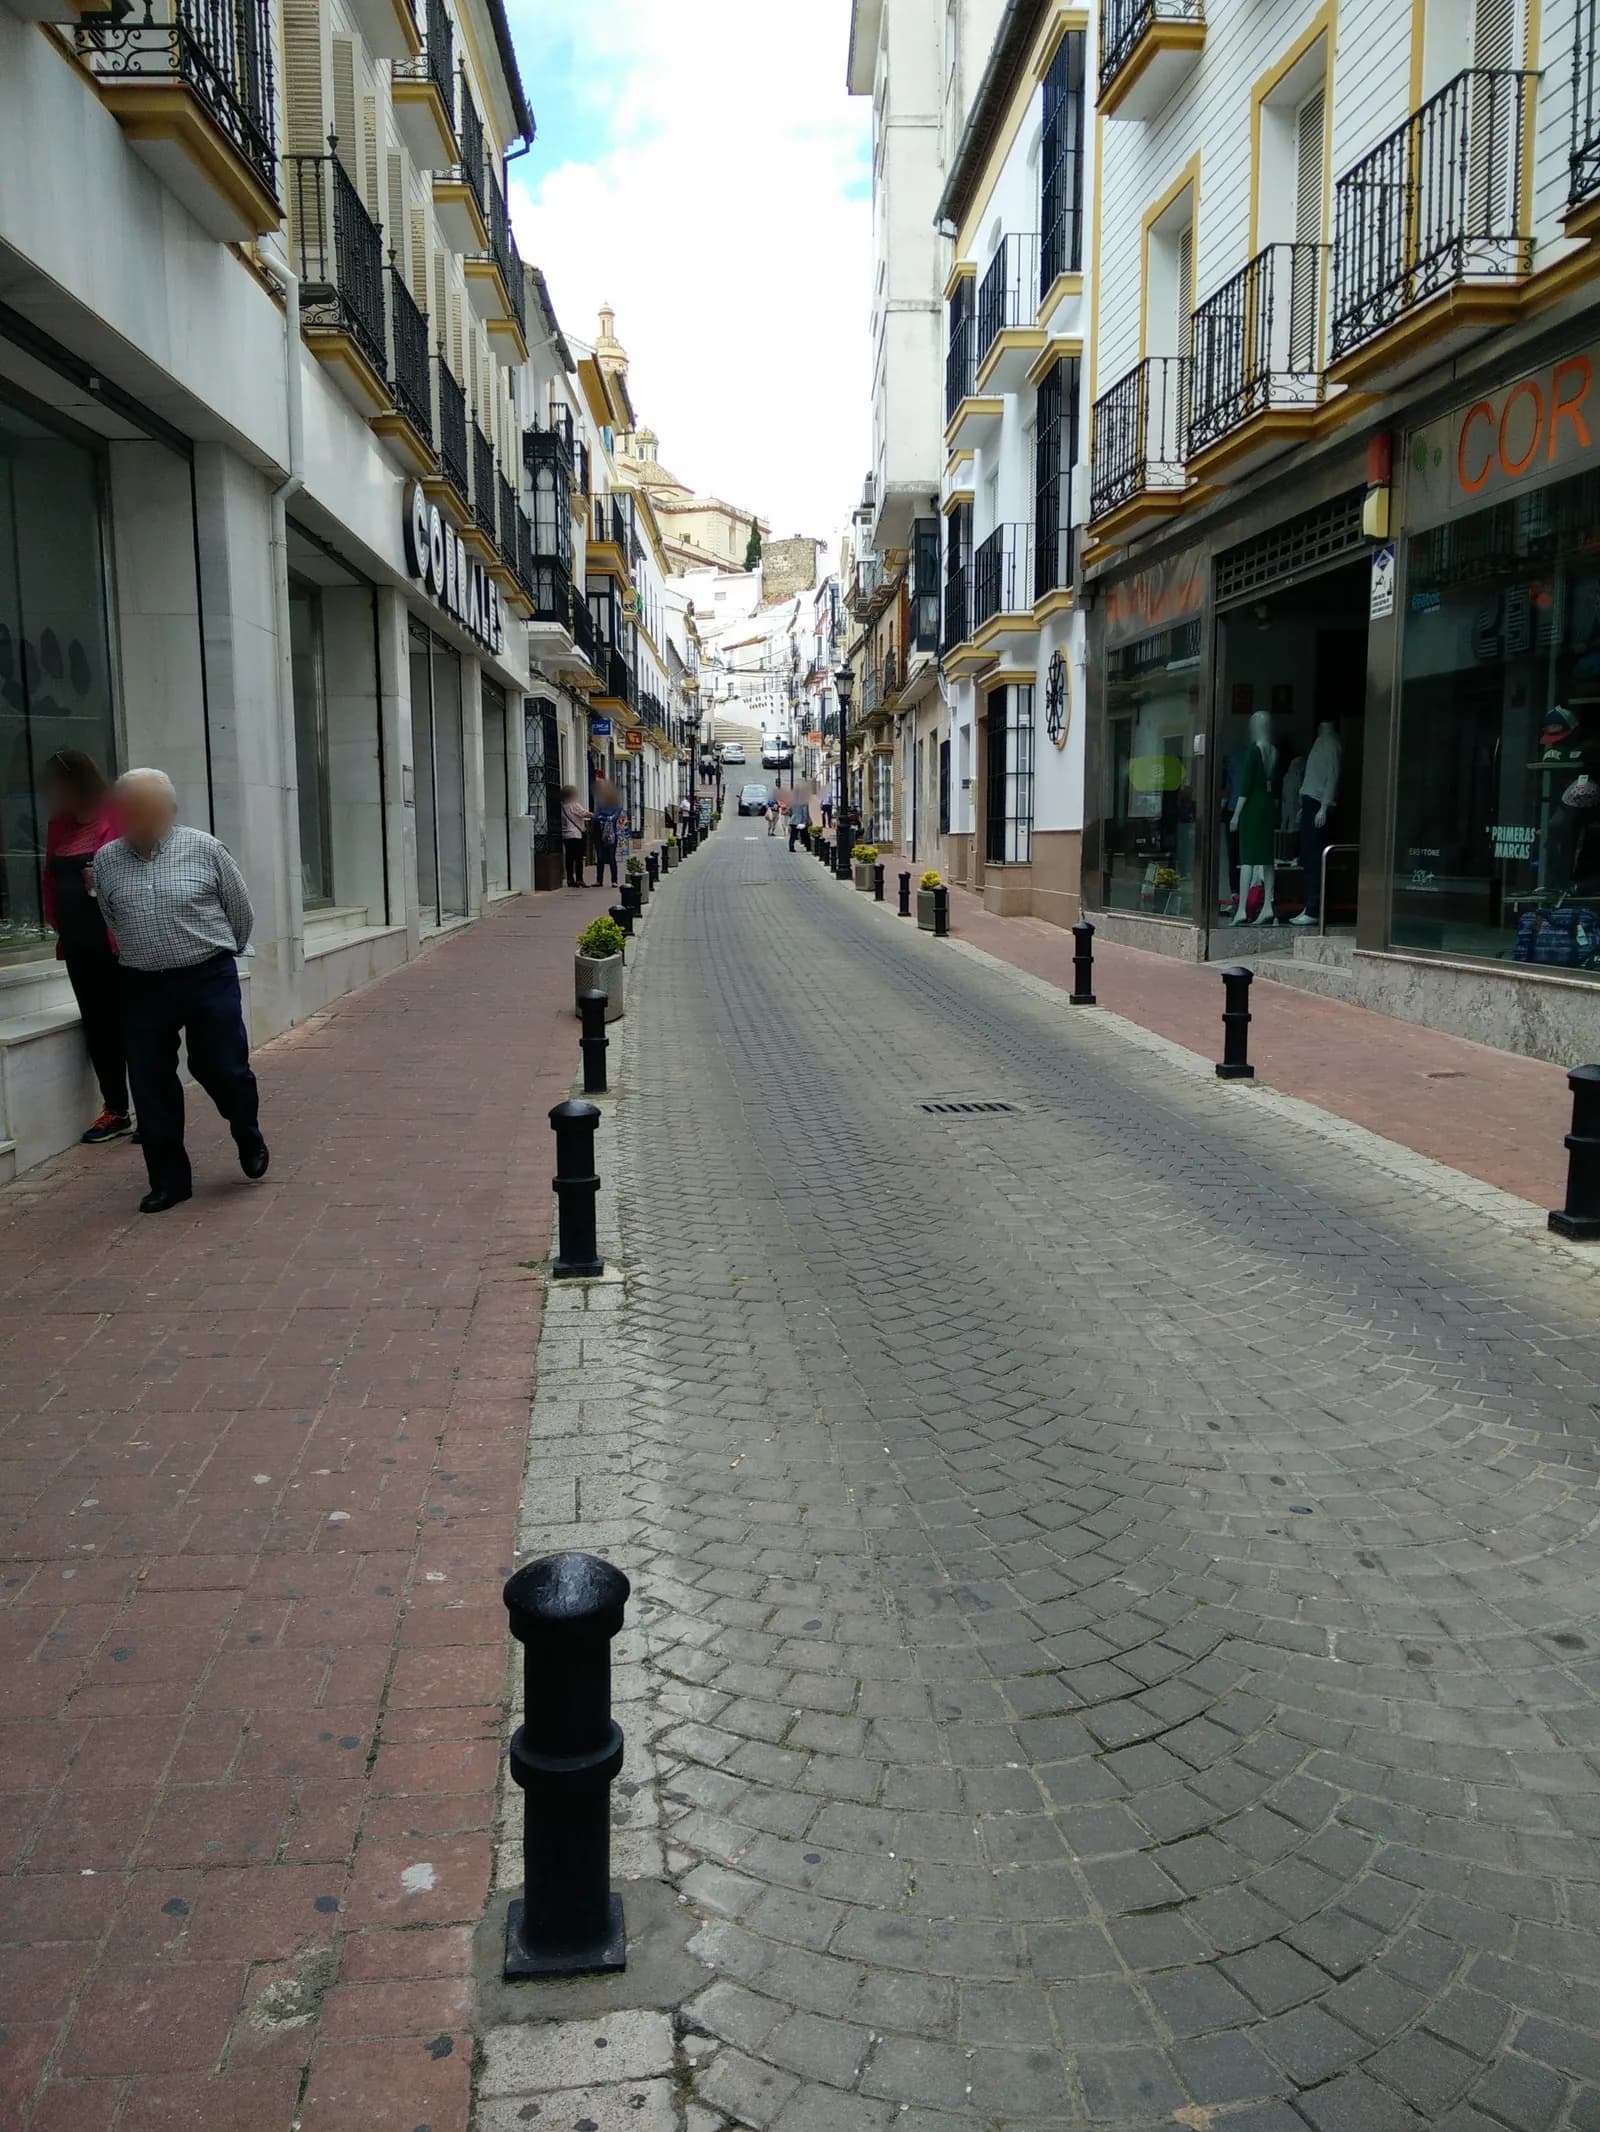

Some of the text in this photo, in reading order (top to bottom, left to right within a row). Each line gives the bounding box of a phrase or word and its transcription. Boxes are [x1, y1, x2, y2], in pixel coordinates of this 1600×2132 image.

[404, 481, 505, 656] CORRALES
[1491, 825, 1536, 843] PRIMERAS
[1494, 842, 1531, 860] MARCAS
